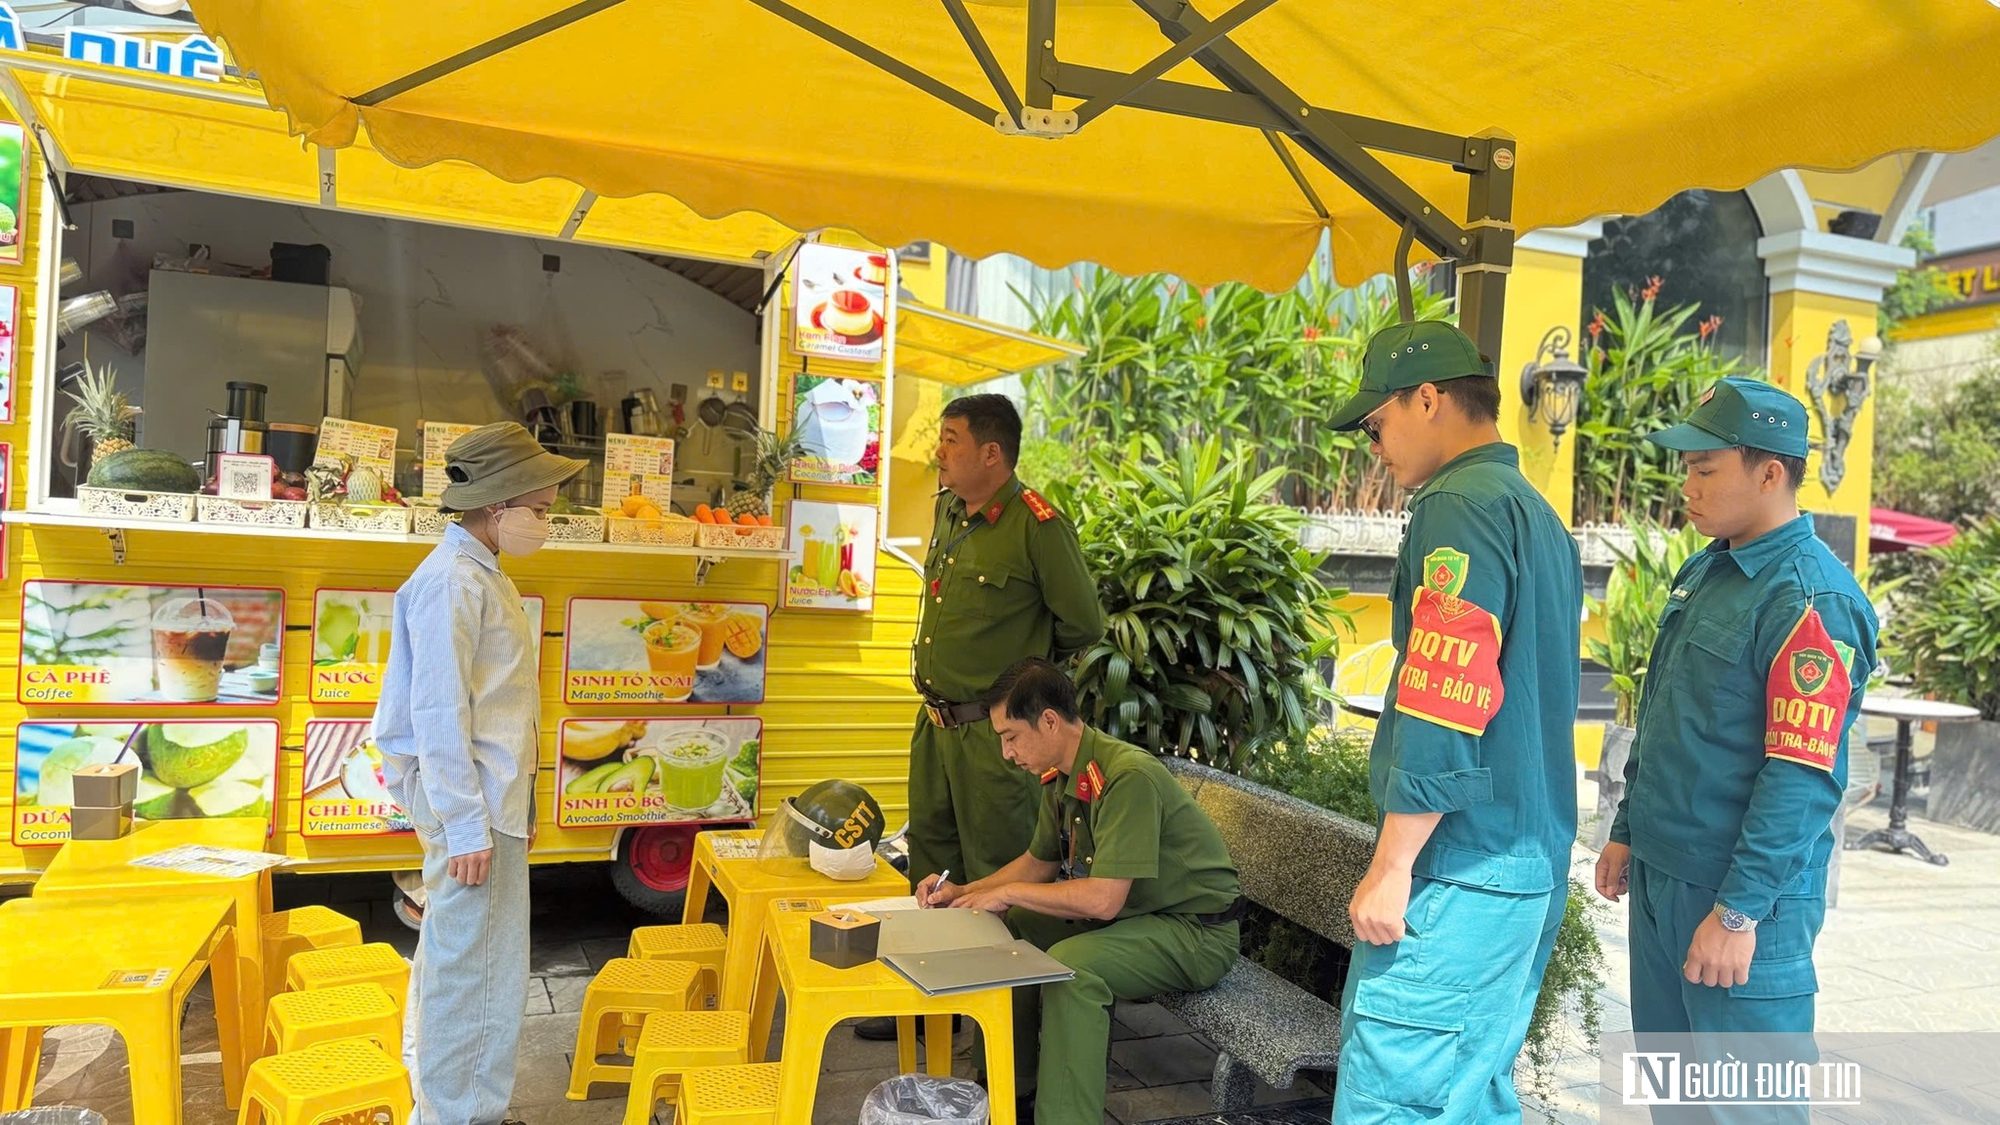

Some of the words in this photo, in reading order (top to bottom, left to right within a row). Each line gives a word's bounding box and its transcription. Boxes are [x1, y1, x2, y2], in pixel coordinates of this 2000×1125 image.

[325, 420, 345, 429] MENU
[608, 437, 626, 445] MENU
[789, 597, 812, 605] Juice
[1410, 627, 1479, 668] DQTV
[26, 668, 58, 683] CÀ
[65, 669, 111, 684] PHÊ
[318, 670, 376, 684] NƯỚC
[571, 675, 615, 687] SINH
[620, 671, 643, 687] TỐ
[648, 673, 692, 687] XOÀI
[1404, 666, 1429, 692] TRA
[1440, 672, 1475, 705] BẢO
[25, 687, 73, 700] Coffee
[317, 688, 350, 698] Juice
[571, 690, 610, 701] Mango
[613, 690, 664, 699] Smoothie
[1772, 697, 1836, 733] DQTV
[564, 798, 608, 811] SINH
[613, 793, 636, 809] TỐ
[641, 795, 665, 808] BƠ
[22, 809, 71, 824] DỪA
[308, 802, 351, 817] CHÈ
[564, 813, 614, 824] Avocado
[616, 811, 667, 822] Smoothie
[834, 800, 876, 849] CSTT
[308, 821, 382, 831] Vietnamese
